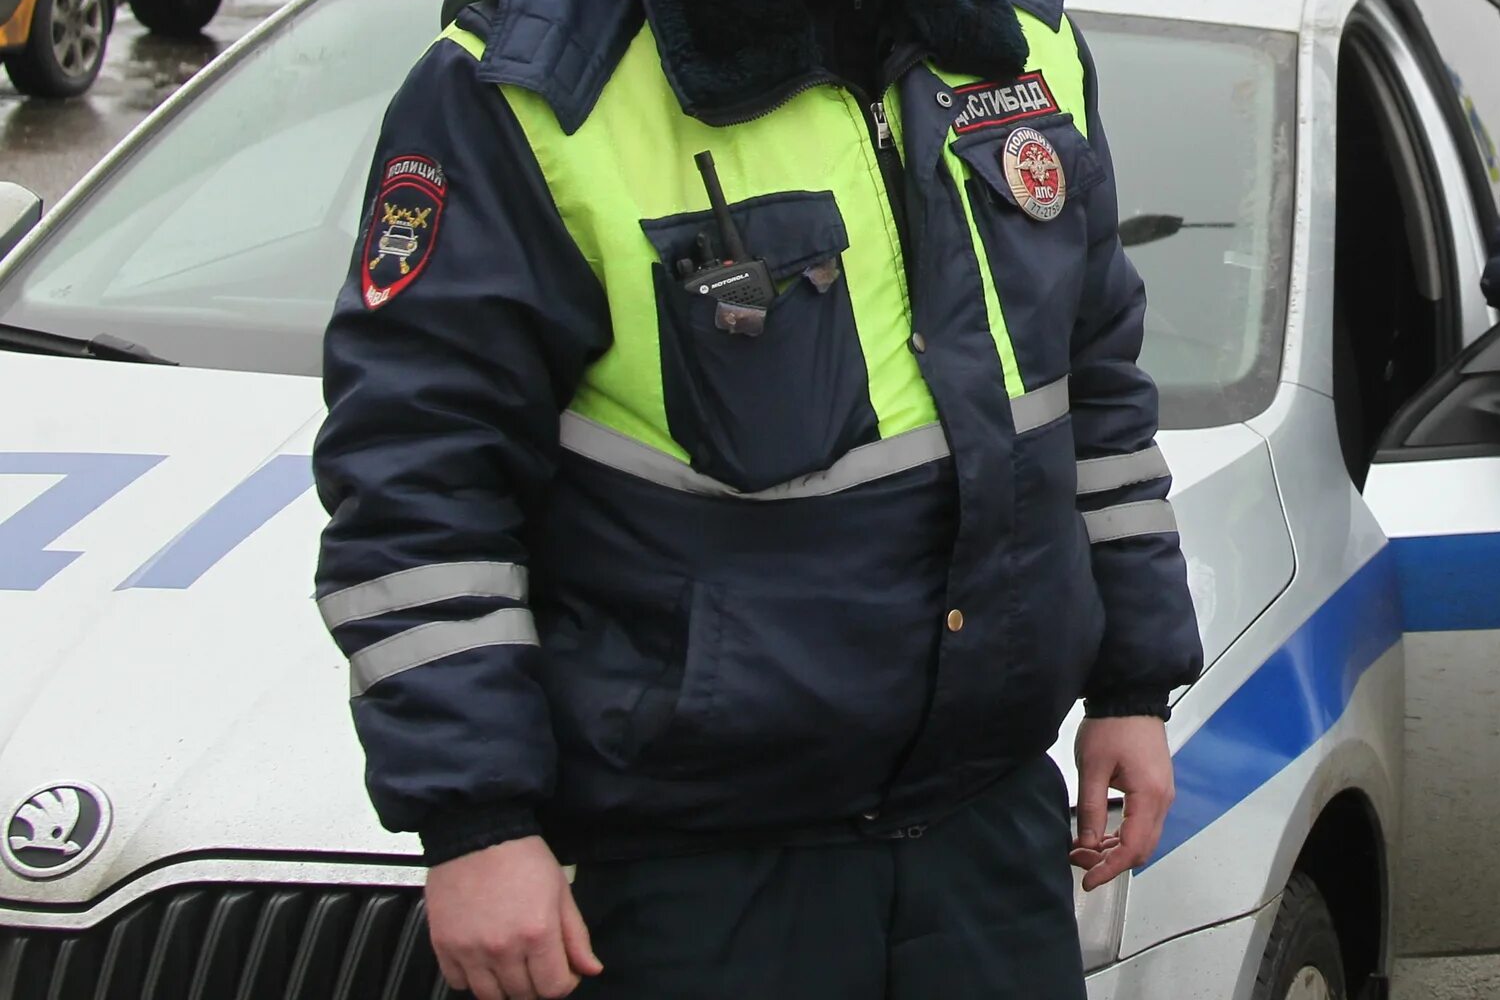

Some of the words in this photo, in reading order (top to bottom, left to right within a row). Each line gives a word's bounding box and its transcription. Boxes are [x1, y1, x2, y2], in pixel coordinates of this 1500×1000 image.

[979, 81, 1050, 115] ГИБДД
[1008, 129, 1054, 155] ПОЛИЦИЯ
[387, 160, 442, 187] ПОЛИЦИЯ
[1034, 185, 1054, 199] ДПС
[711, 272, 750, 290] MOTOROLA
